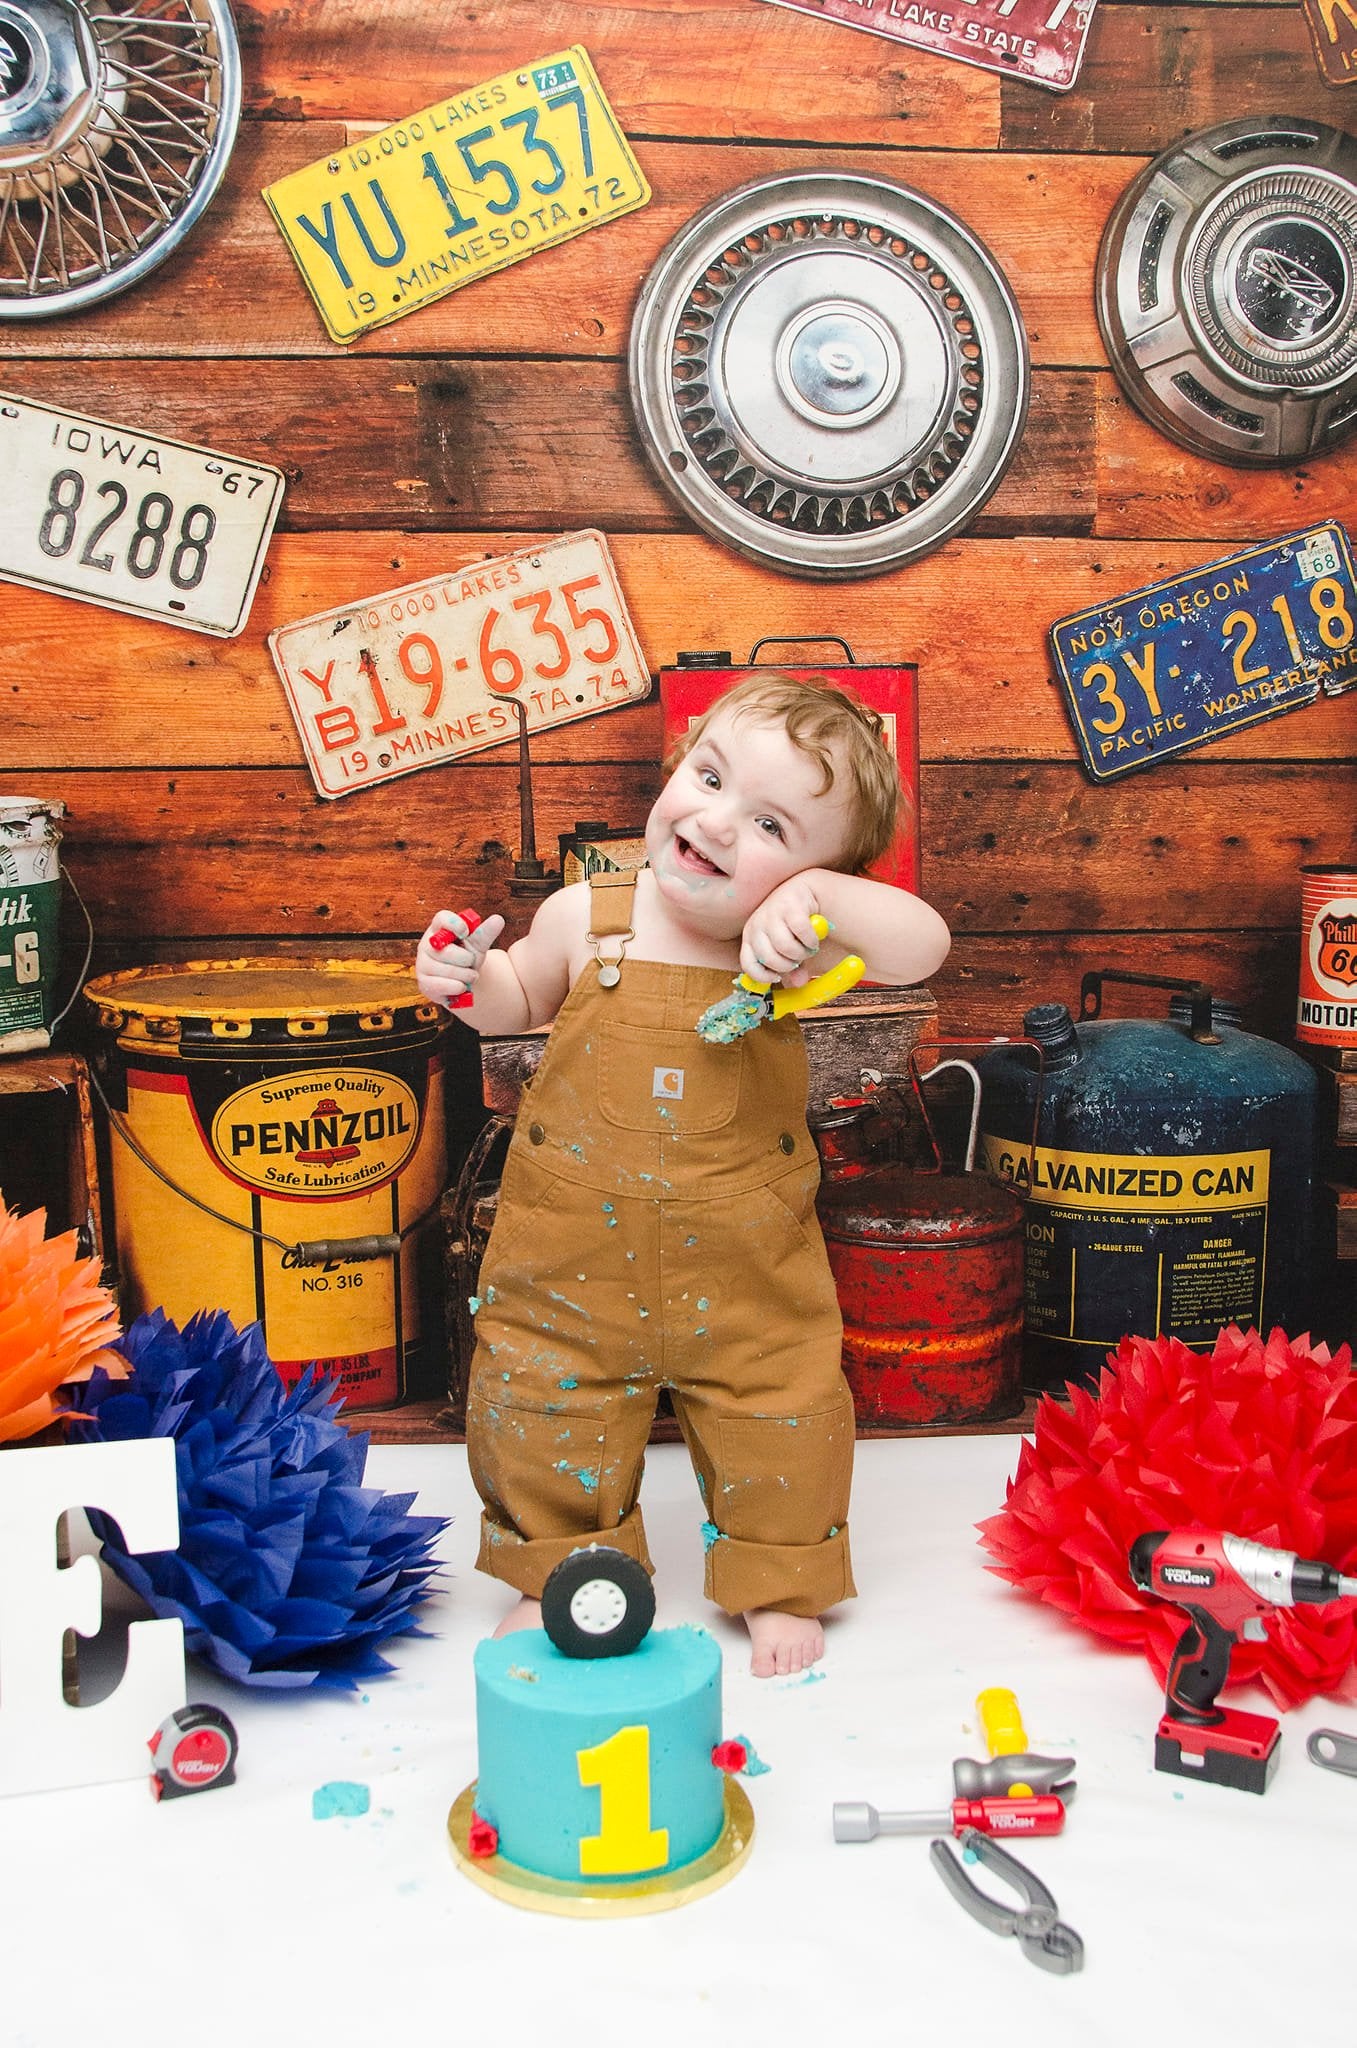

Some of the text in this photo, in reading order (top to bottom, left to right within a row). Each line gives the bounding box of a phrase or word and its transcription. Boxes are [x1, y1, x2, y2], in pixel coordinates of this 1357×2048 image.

[889, 0, 953, 33] LAKE
[964, 22, 1038, 58] STATE
[537, 69, 558, 90] 73
[432, 84, 509, 133] LAKES
[295, 89, 595, 290] YU 1537
[346, 177, 627, 320] 19 MINNESOTA 72
[52, 423, 162, 475] IOWA
[221, 472, 264, 499] 67
[38, 468, 217, 591] 8288
[444, 563, 523, 606] LAKES
[1312, 553, 1336, 573] 68
[1138, 571, 1251, 628] OREGON
[1221, 576, 1356, 687] 218
[300, 659, 337, 702] Y
[1100, 644, 1357, 758] PACIFIC WONDERLAND
[314, 706, 360, 753] B
[338, 667, 630, 777] 19 MINNESOTA 74
[260, 1077, 385, 1104] Supreme Quality
[230, 1102, 411, 1157] PENNZOIL
[264, 1160, 387, 1187] Safe Lubrication
[999, 1152, 1255, 1198] GALVANIZED CAN
[1050, 1210, 1085, 1222] CAPACITY:
[1191, 1216, 1213, 1225] LITERS
[1123, 1244, 1144, 1253] STEEL
[1202, 1238, 1233, 1249] DANGER
[302, 1272, 364, 1293] NO. 316
[340, 1367, 382, 1386] COMPANY
[1166, 1573, 1211, 1586] TOUGH
[576, 1724, 670, 1876] 1
